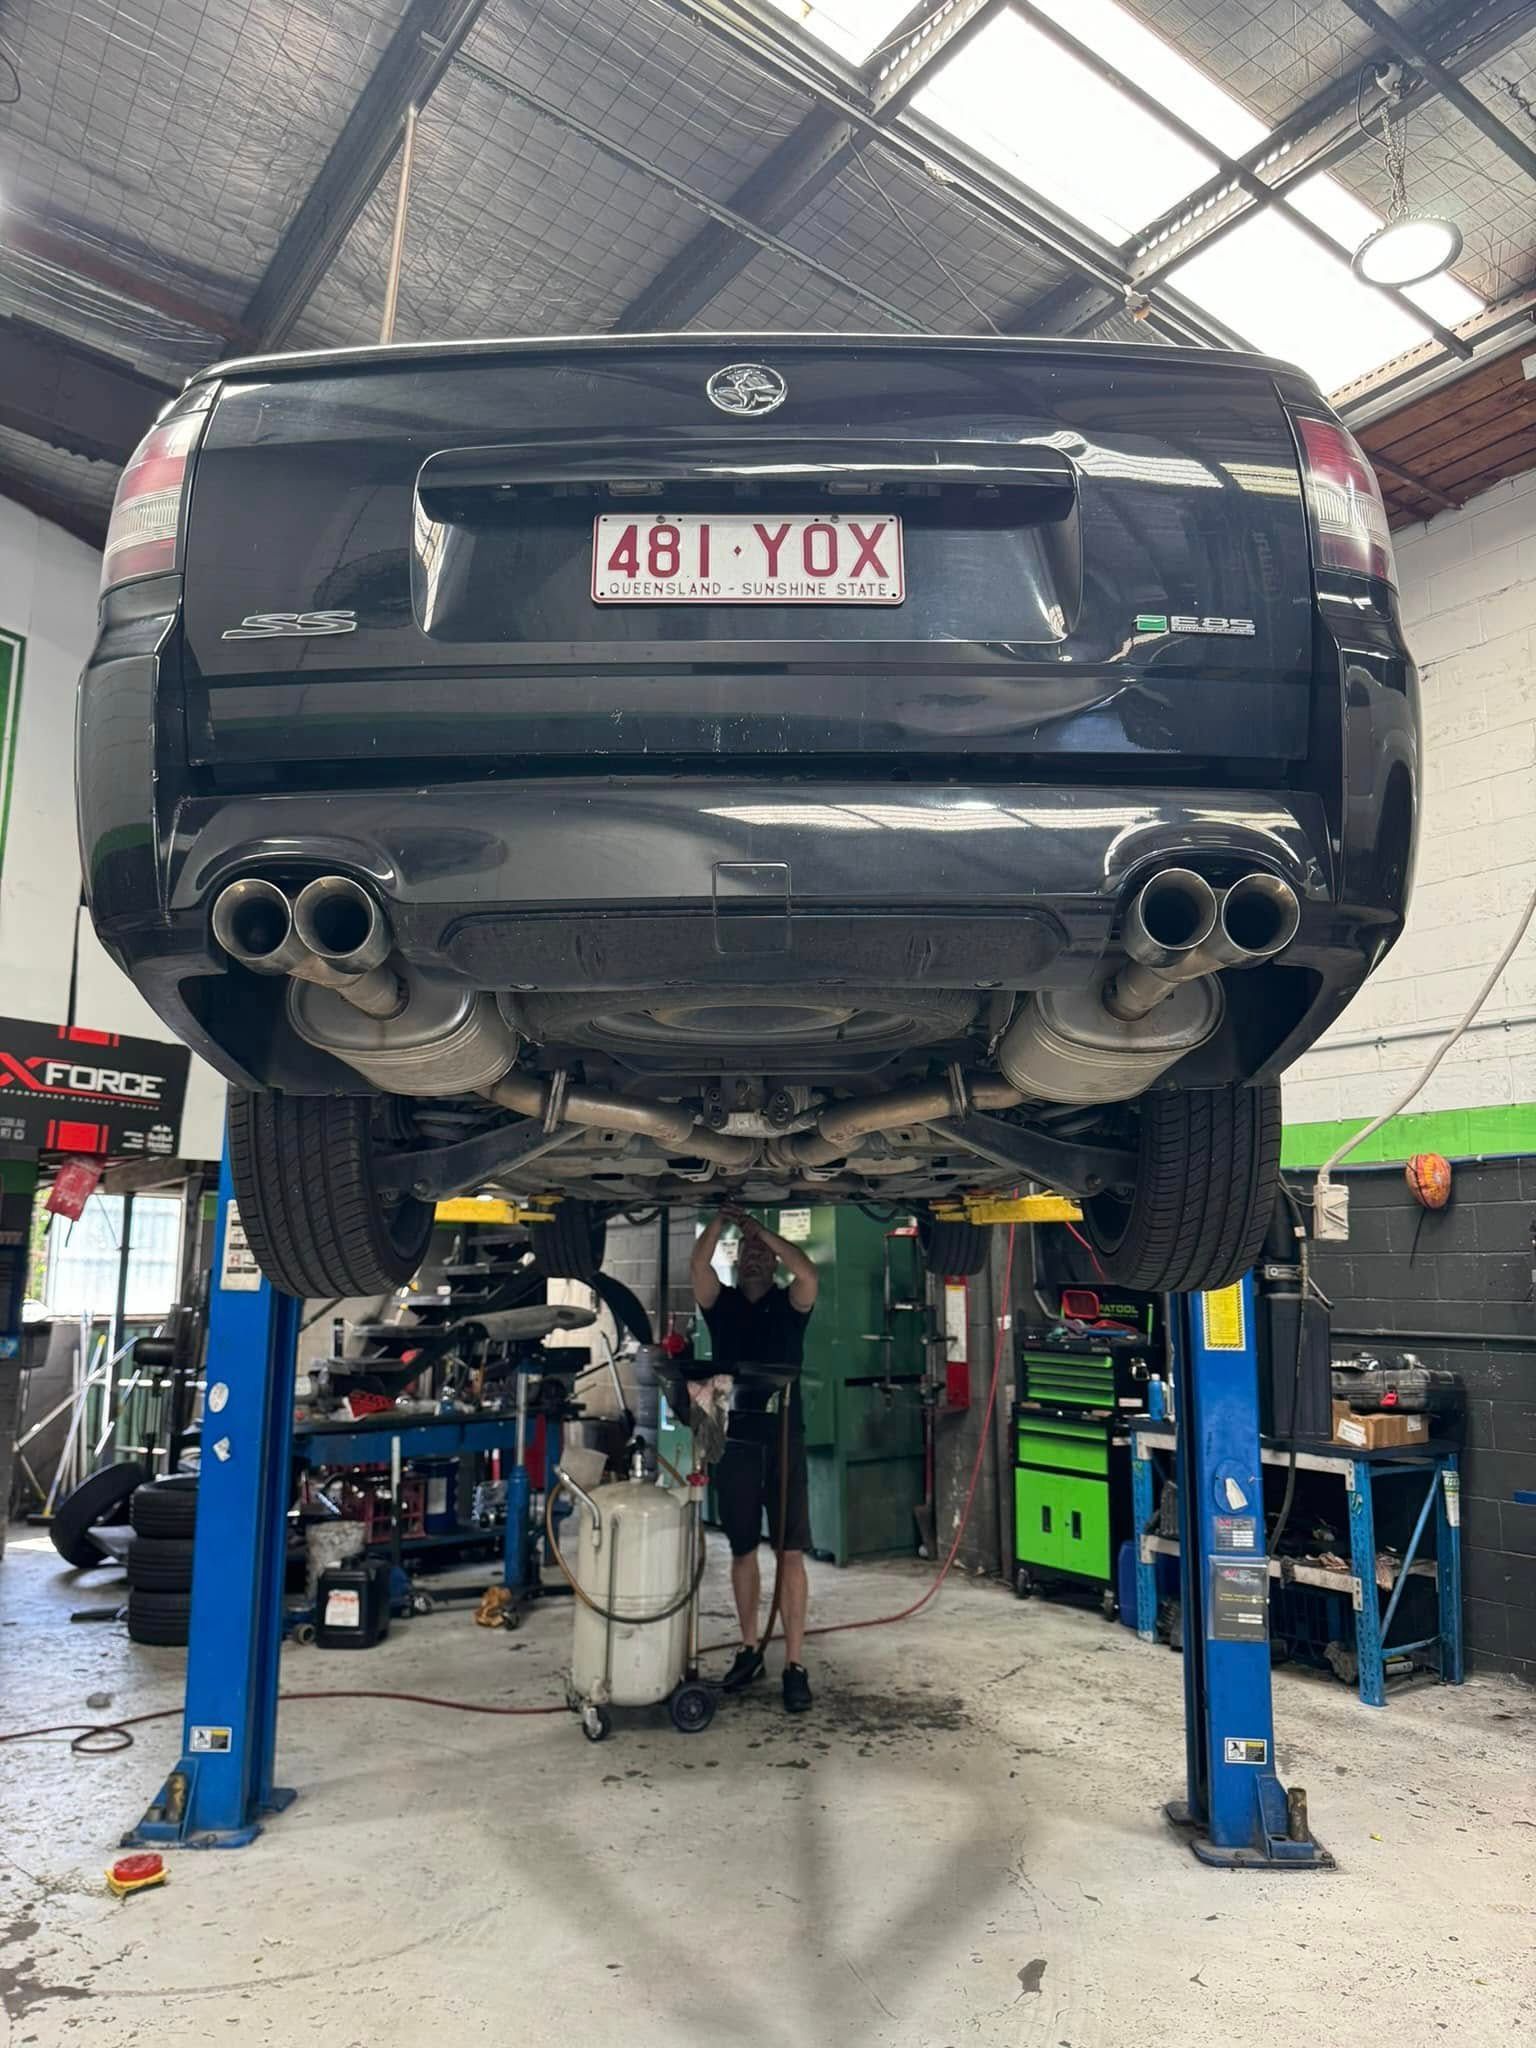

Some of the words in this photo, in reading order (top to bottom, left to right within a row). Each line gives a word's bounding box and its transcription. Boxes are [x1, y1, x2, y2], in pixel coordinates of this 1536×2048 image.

[608, 524, 710, 579] 481
[753, 523, 890, 578] YOX
[609, 582, 722, 596] QUEENSLAND
[742, 582, 827, 597] SUNSHINE
[837, 583, 888, 597] STATE
[221, 610, 357, 640] SS
[1171, 616, 1256, 630] E85
